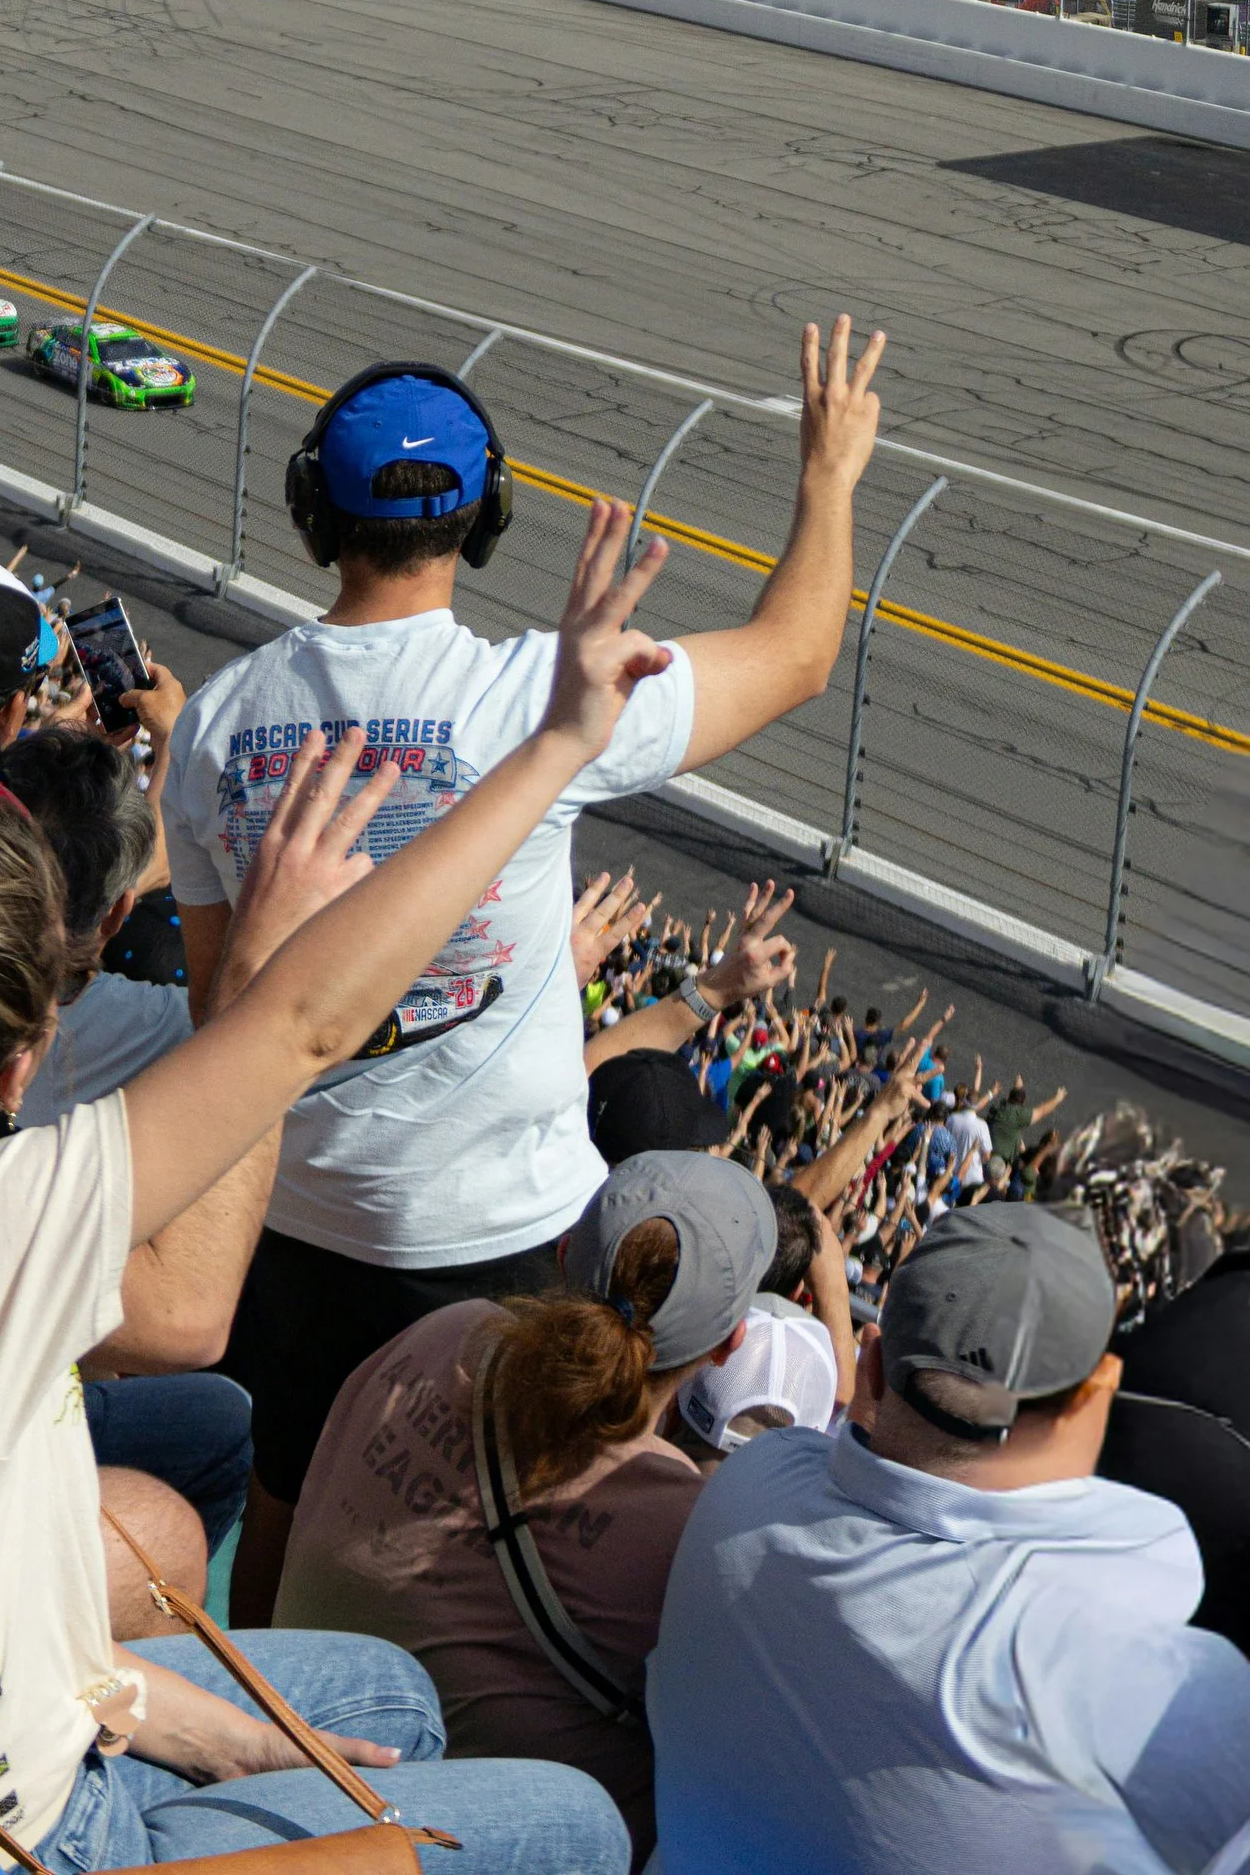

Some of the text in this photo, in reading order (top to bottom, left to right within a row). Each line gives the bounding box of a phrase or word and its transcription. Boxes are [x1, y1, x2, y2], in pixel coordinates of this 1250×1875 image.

[366, 718, 452, 745] SERIES
[455, 977, 475, 1009] 26
[414, 1006, 448, 1021] NASCAR
